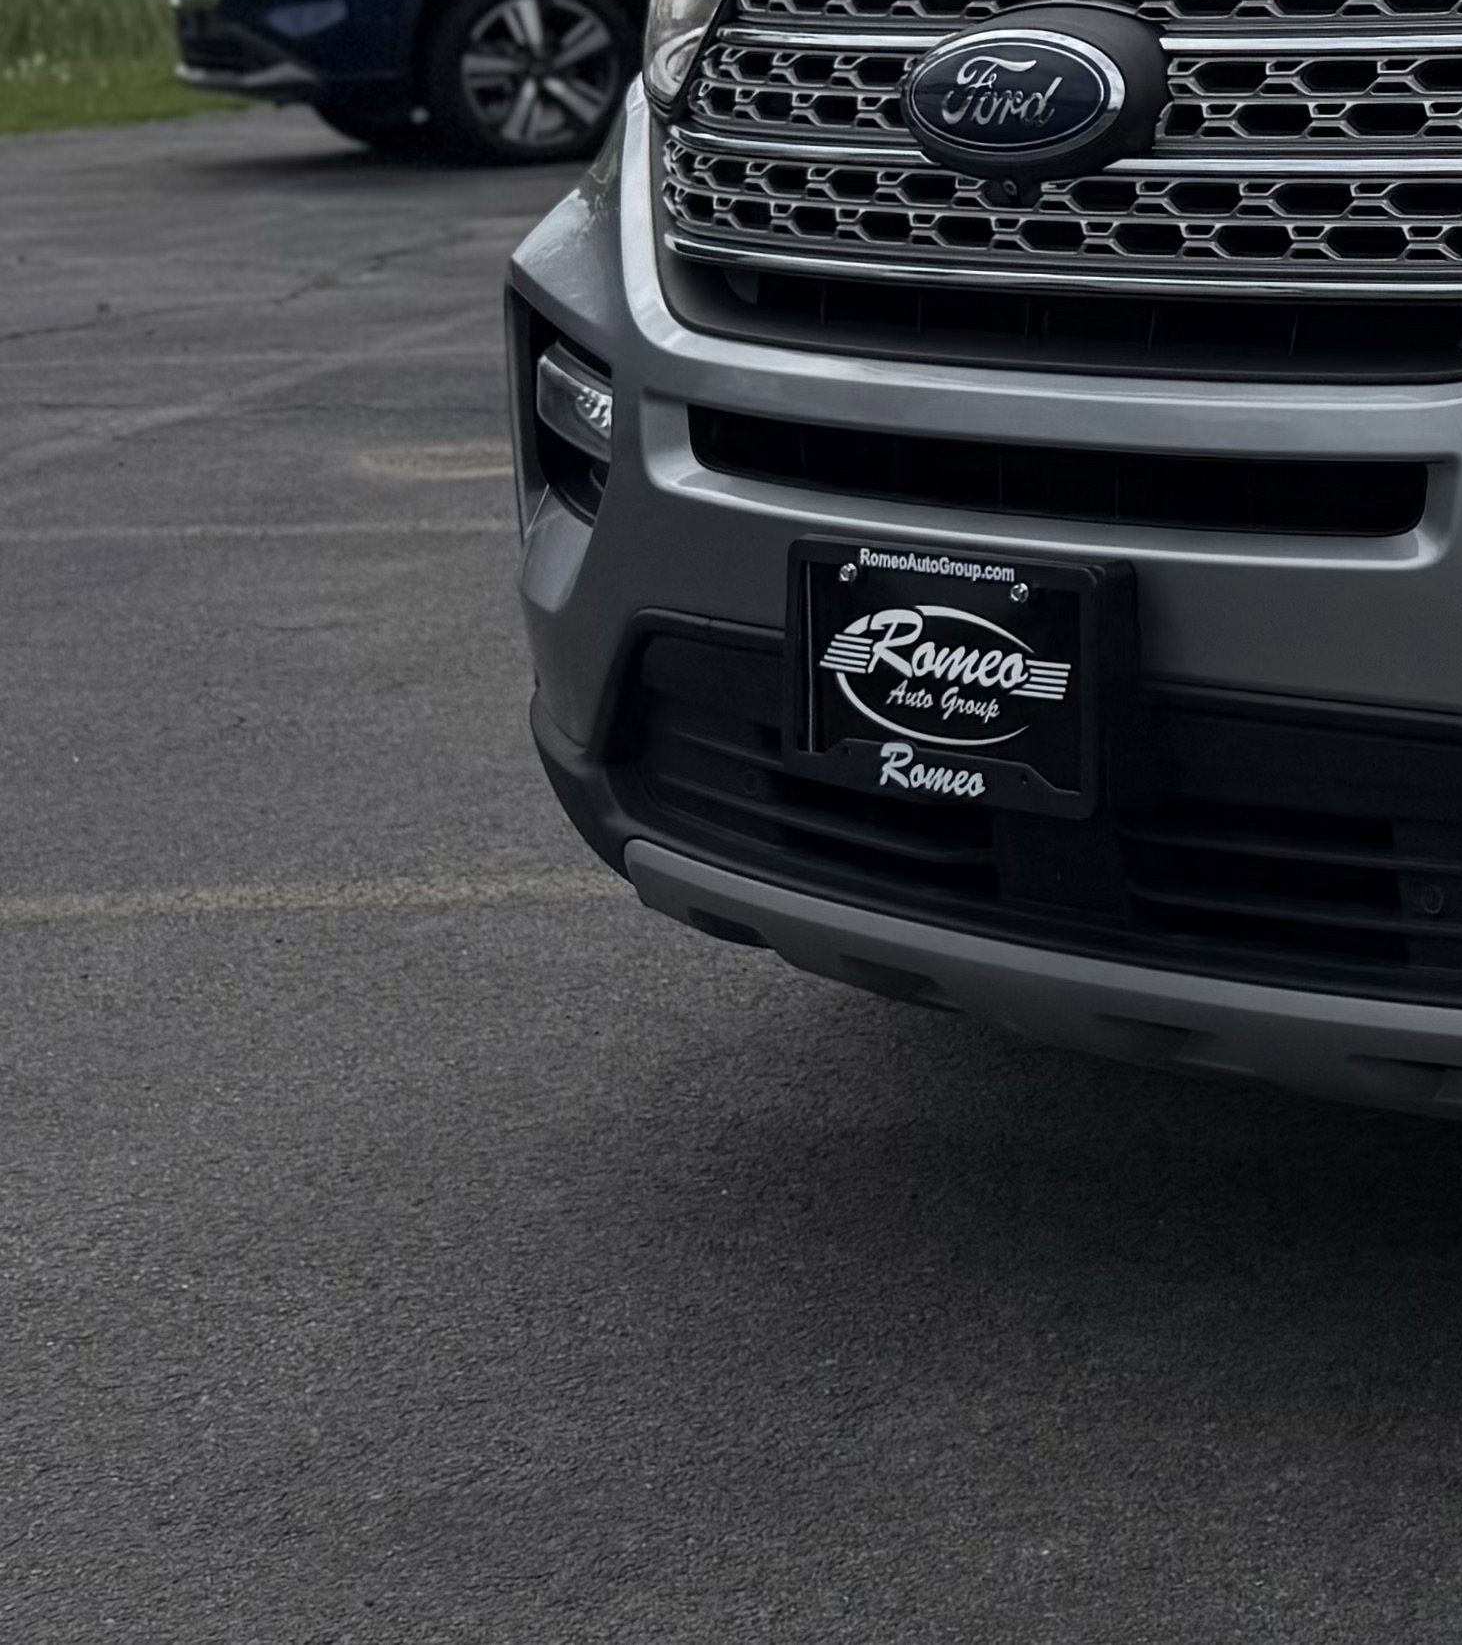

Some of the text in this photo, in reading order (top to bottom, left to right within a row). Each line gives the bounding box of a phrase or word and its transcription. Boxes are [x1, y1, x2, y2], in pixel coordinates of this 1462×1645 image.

[942, 56, 1063, 126] Ford
[859, 547, 1016, 583] RomeoAutoGroup.com
[868, 609, 1029, 688] Romeo
[886, 679, 1001, 723] Auto Group
[879, 742, 986, 797] Romeo
